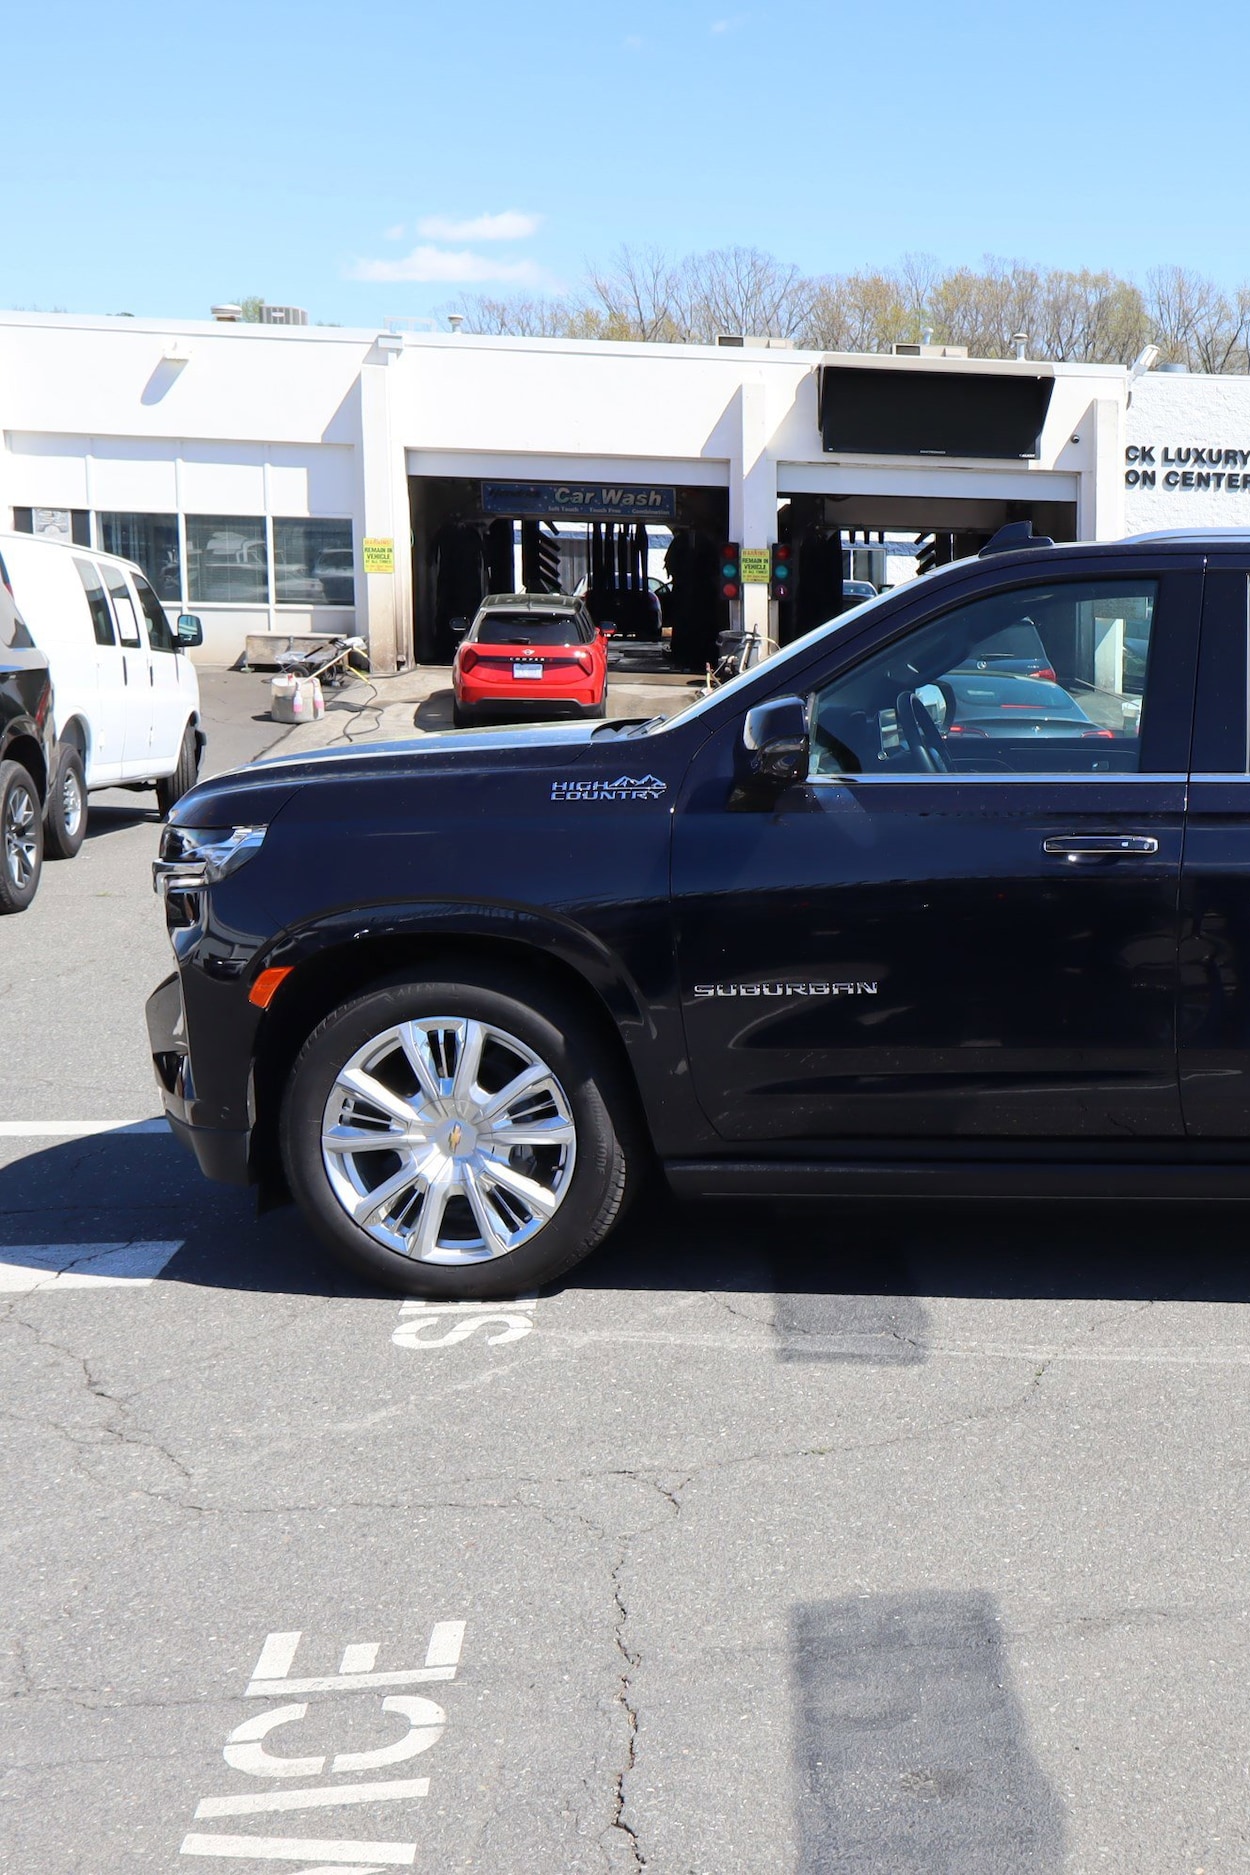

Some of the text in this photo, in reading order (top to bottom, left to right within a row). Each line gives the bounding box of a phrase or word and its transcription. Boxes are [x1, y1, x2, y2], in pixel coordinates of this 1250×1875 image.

[1125, 445, 1155, 463] CK
[1125, 469, 1156, 486] ON
[554, 487, 594, 504] Car
[601, 488, 662, 506] Wash
[551, 781, 609, 791] HIGH
[550, 790, 666, 801] COUNTRY
[693, 981, 878, 997] SUBURBAN
